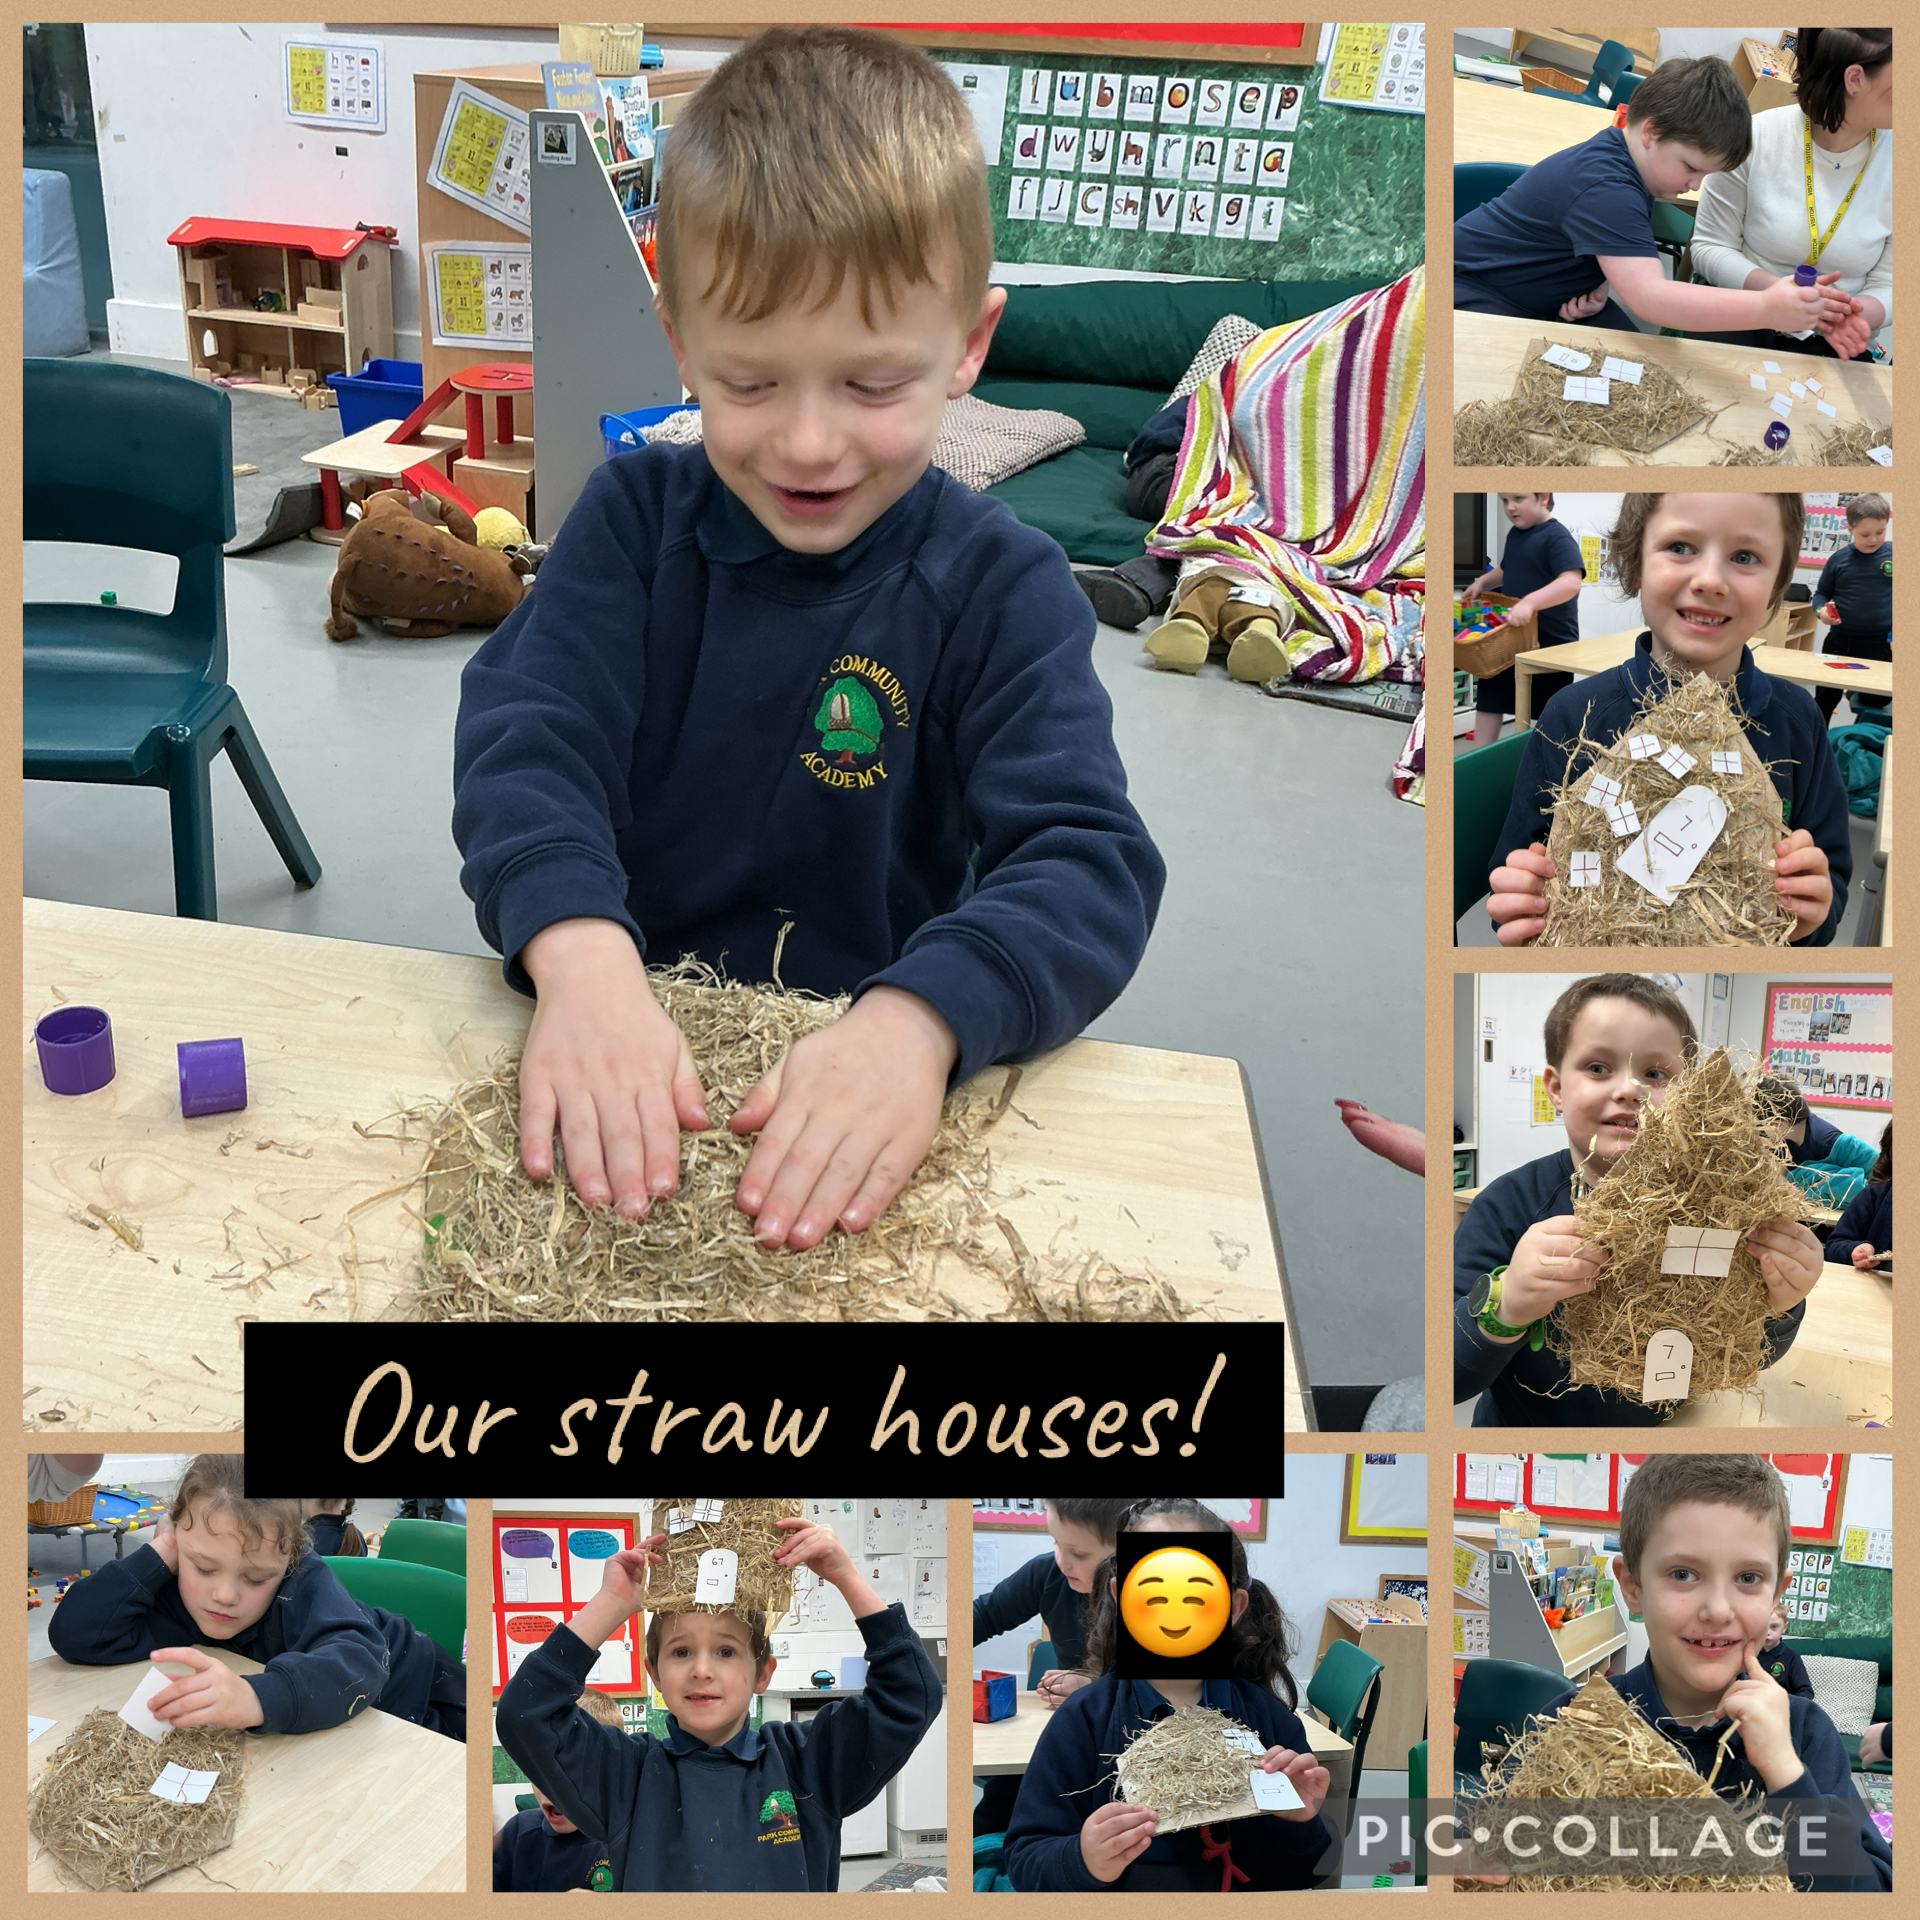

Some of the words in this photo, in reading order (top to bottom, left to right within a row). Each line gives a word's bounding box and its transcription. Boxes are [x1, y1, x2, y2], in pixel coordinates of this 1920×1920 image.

[1828, 213, 1842, 234] VISITOR
[830, 654, 911, 728] COMMUNITY
[800, 751, 888, 789] ACADEMY
[1778, 993, 1846, 1015] English
[1769, 1049, 1821, 1066] Maths
[1663, 1344, 1674, 1359] 7
[711, 1557, 724, 1566] 67
[757, 1831, 778, 1843] PARK
